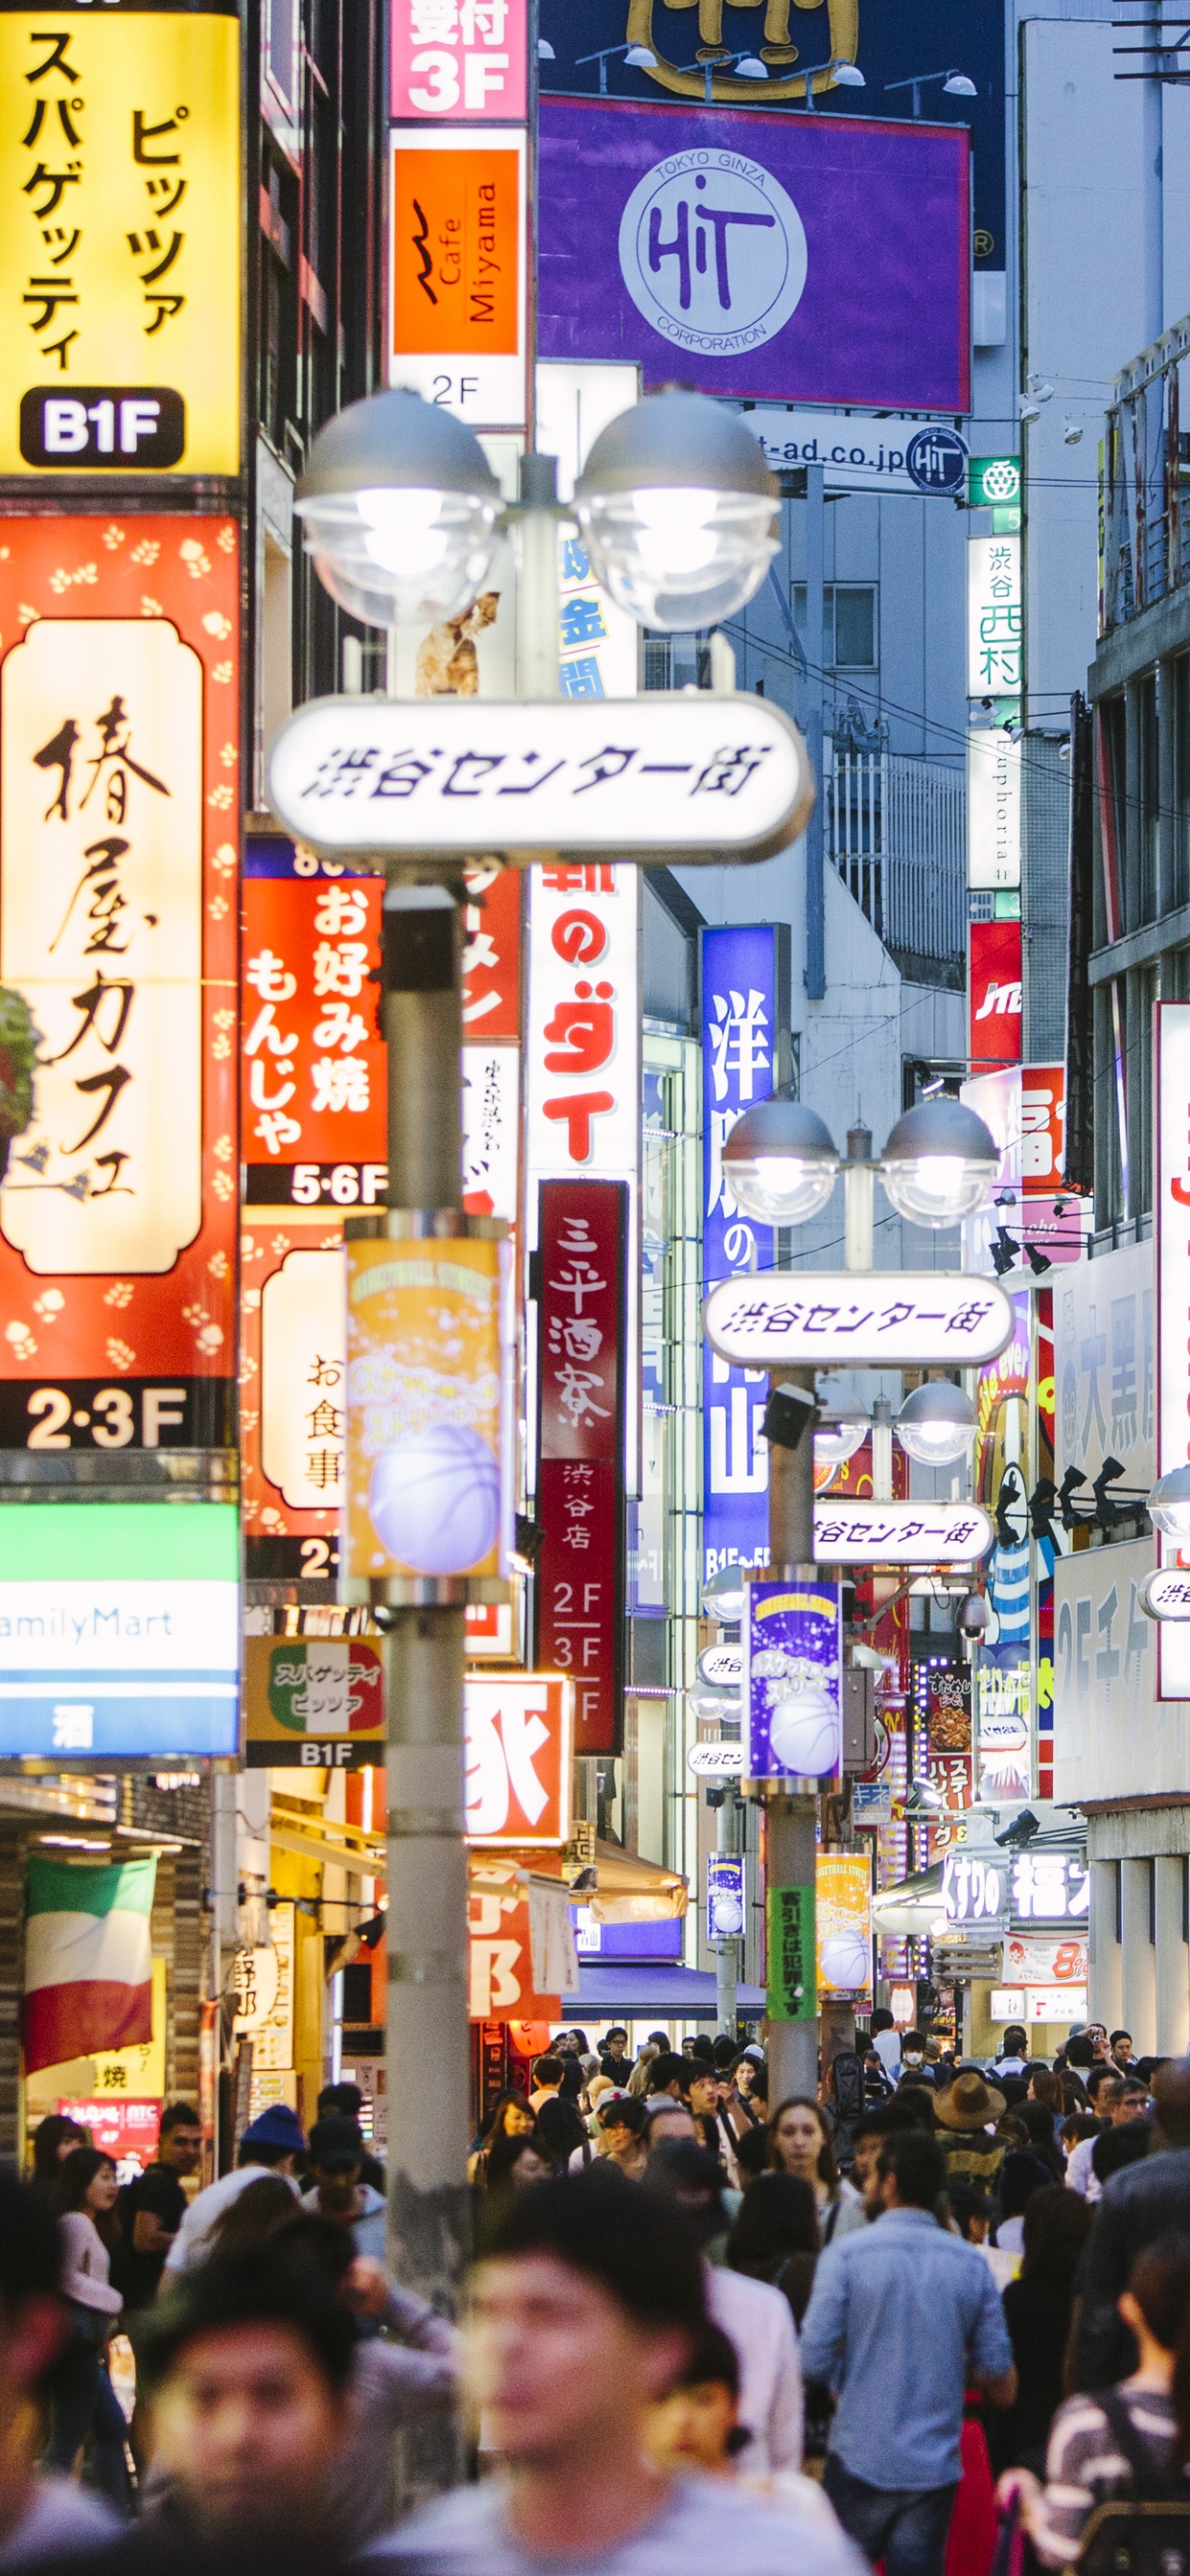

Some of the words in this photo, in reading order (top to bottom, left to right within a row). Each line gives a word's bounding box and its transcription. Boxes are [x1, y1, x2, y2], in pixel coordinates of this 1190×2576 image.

[410, 0, 509, 45] 受付
[408, 51, 510, 112] 3F
[654, 151, 710, 180] TOKYO
[719, 153, 766, 188] GINZA
[22, 32, 84, 372] スパゲッティ
[128, 105, 190, 334] ピッツァ
[439, 218, 462, 287] Cafe
[469, 182, 496, 324] Miyama
[657, 315, 767, 351] CORPORATION
[433, 375, 480, 406] 2F
[42, 400, 161, 452] B1F
[300, 745, 777, 798] 渋谷センター街
[993, 739, 1013, 862] Euphoria
[33, 695, 174, 1198] 椿屋カフェ
[314, 885, 372, 1114] お好み焼
[245, 949, 302, 1156] もんじゃ
[721, 1300, 994, 1334] 渋谷センター街
[561, 1463, 596, 1551] 渋谷店
[553, 1582, 602, 1614] 2F
[276, 1663, 380, 1686] スパゲッティ
[553, 1637, 602, 1668] 3F
[53, 1705, 95, 1750] 酒
[301, 1742, 353, 1766] B1F
[944, 1855, 999, 1920] くすりの
